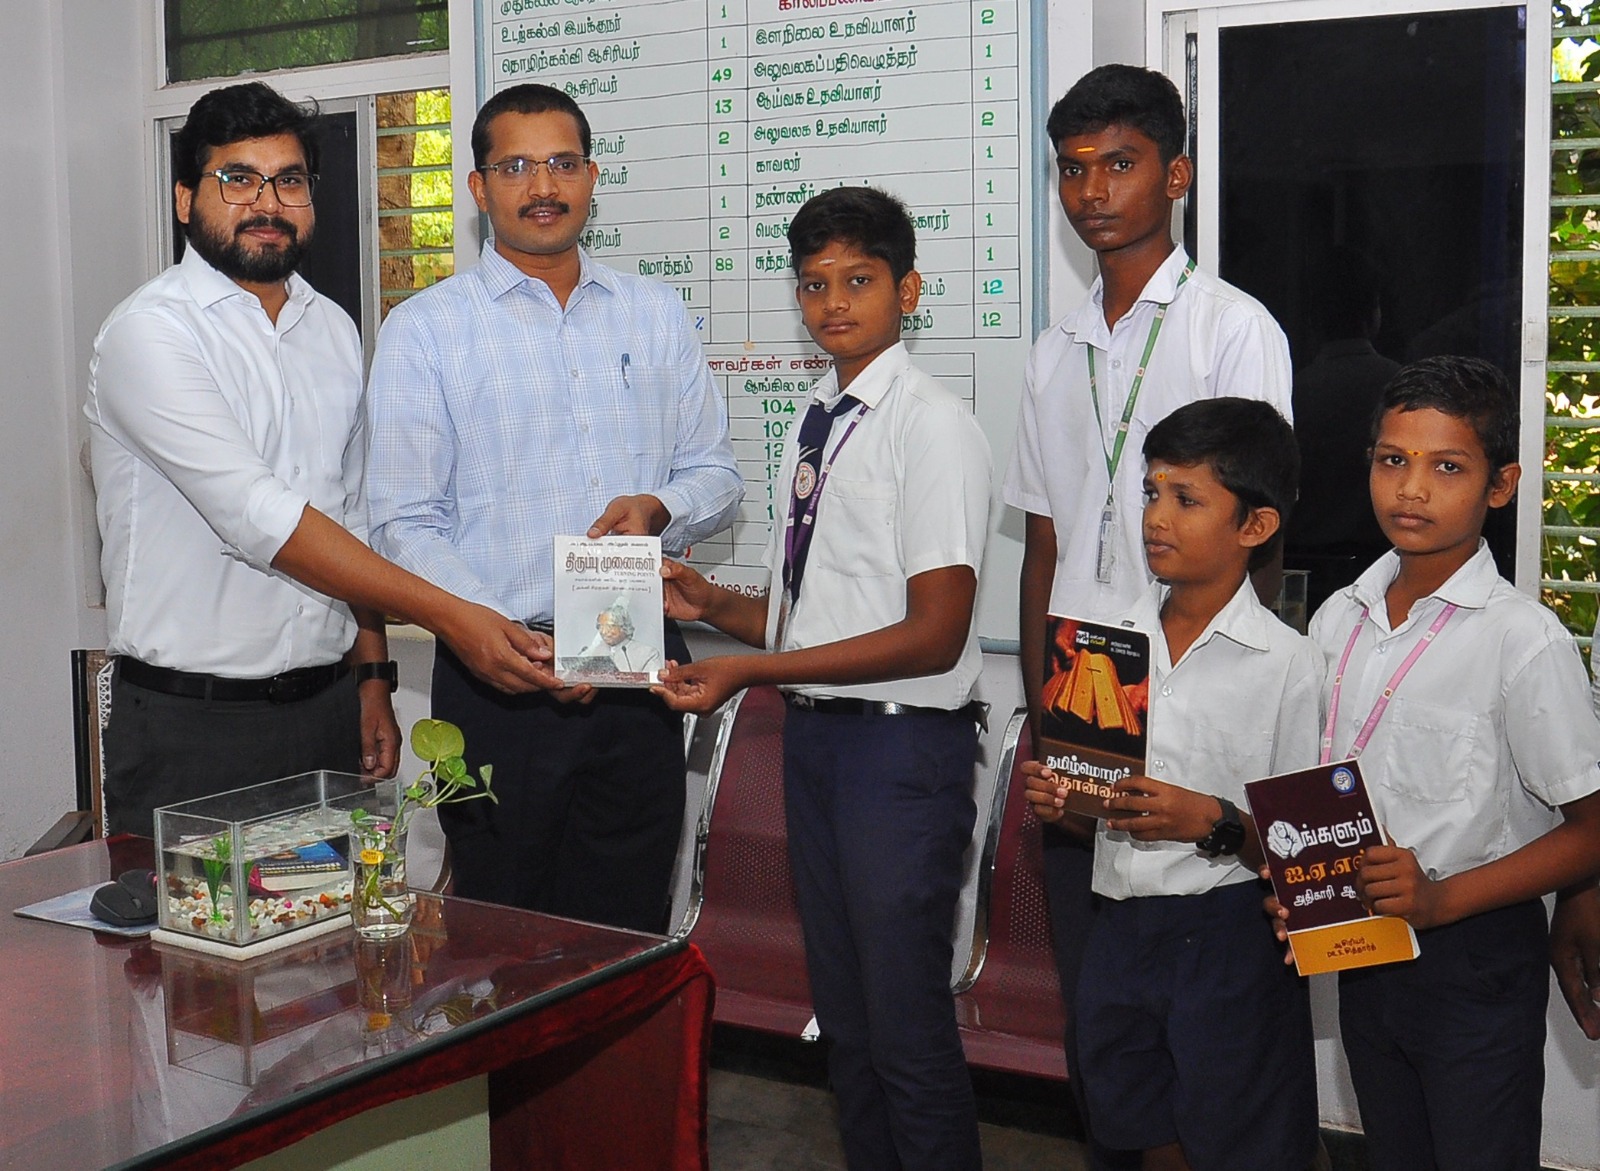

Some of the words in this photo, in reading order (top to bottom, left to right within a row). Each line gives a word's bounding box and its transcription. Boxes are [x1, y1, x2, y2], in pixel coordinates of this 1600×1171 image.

[829, 9, 917, 38] உதவியாளர்
[981, 9, 994, 24] 2
[721, 37, 727, 49] 1
[501, 47, 583, 75] தொழிற்கல்வி
[587, 40, 641, 64] ஆசிரியர்
[985, 44, 992, 57] 1
[711, 68, 732, 82] 49
[564, 75, 618, 99] ஆசிரியர்
[984, 77, 992, 90] 1
[806, 79, 882, 105] உதவியாளர்
[715, 99, 732, 114] 13
[981, 112, 994, 126] 2
[754, 125, 811, 145] அலுவலக
[815, 112, 888, 139] உதவியாளர்
[718, 131, 730, 145] 2
[986, 145, 994, 158] 1
[755, 151, 801, 173] காவலர்
[721, 163, 727, 177] 1
[986, 180, 994, 193] 1
[721, 195, 727, 208] 1
[986, 213, 993, 226] 1
[718, 226, 730, 240] 2
[987, 249, 994, 261] 1
[638, 254, 693, 277] மொத்தம்
[715, 257, 733, 271] 88
[982, 279, 1004, 294] 12
[982, 312, 1001, 327] 12
[761, 399, 797, 415] 104
[600, 551, 656, 573] முனைகள்
[1293, 884, 1335, 907] அதிகாரி
